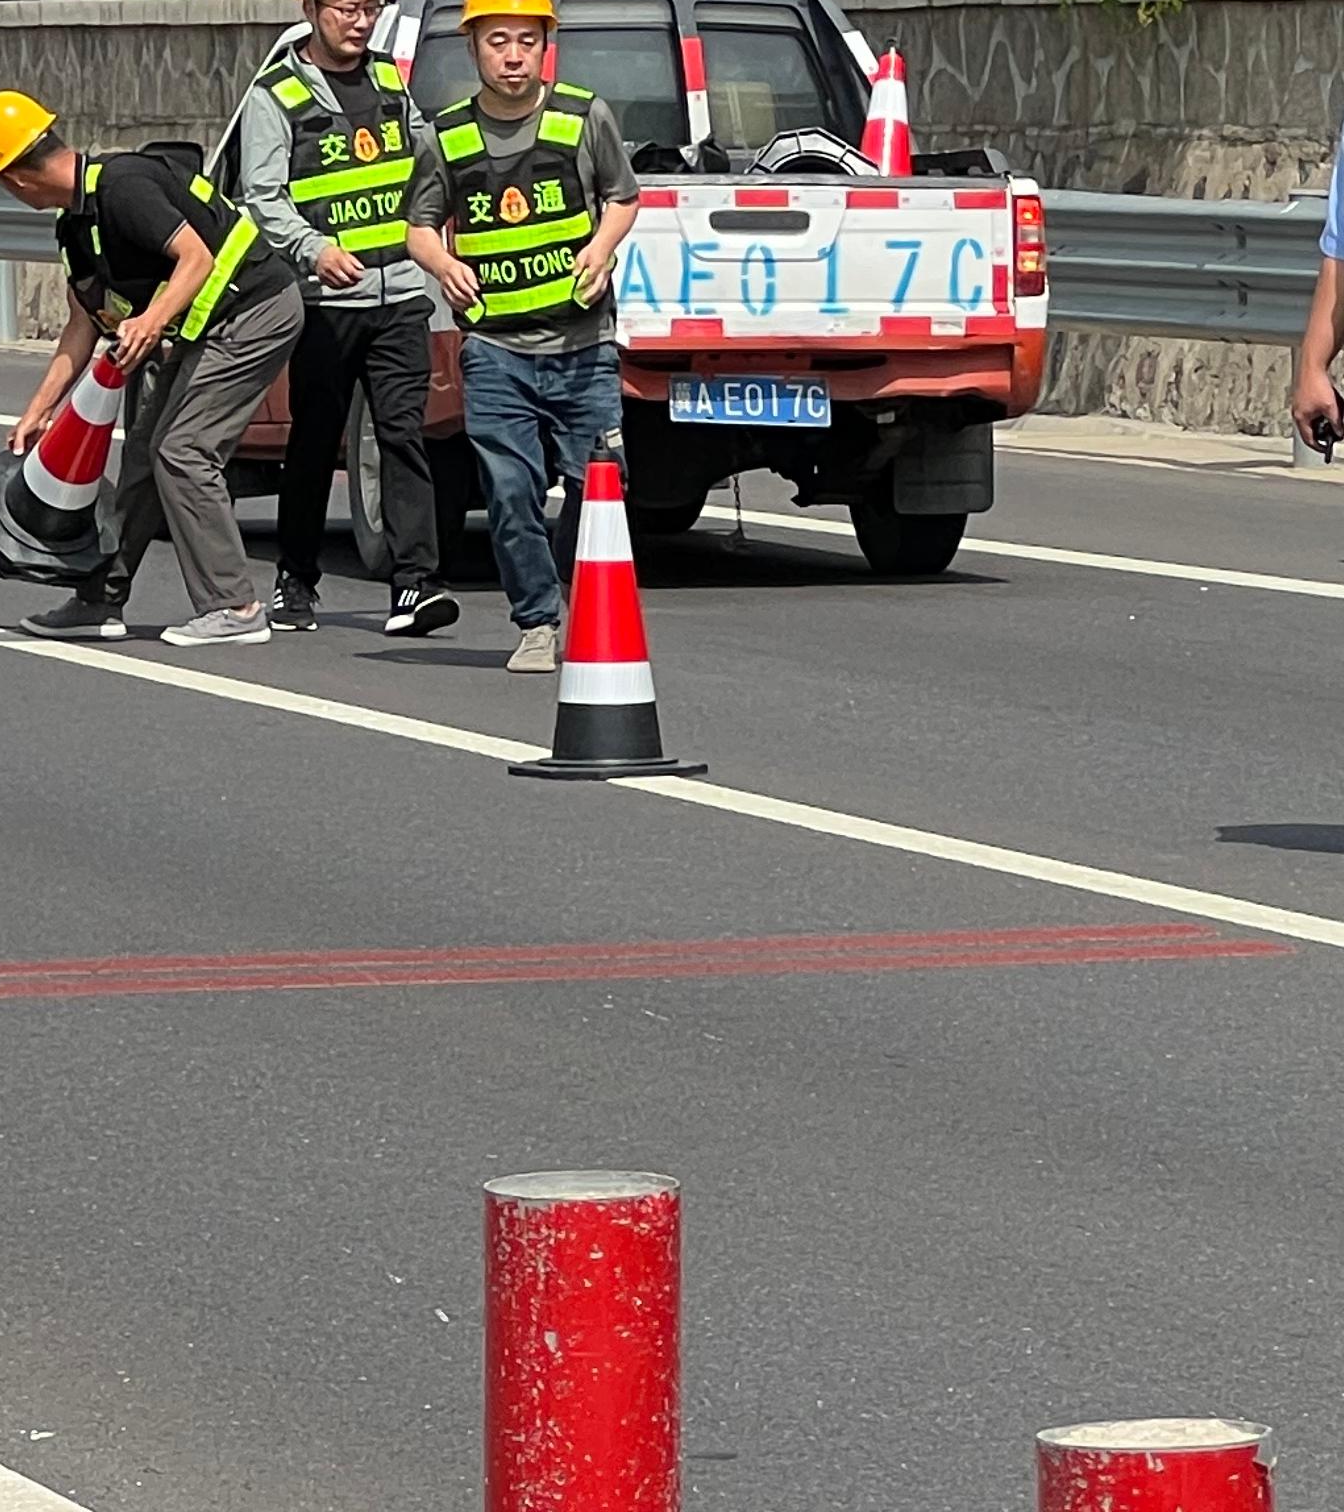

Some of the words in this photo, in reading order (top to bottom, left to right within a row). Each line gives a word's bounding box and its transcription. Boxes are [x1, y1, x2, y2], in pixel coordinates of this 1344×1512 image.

[328, 196, 372, 225] JIAO
[479, 260, 517, 284] JIAO
[519, 247, 576, 280] TONG
